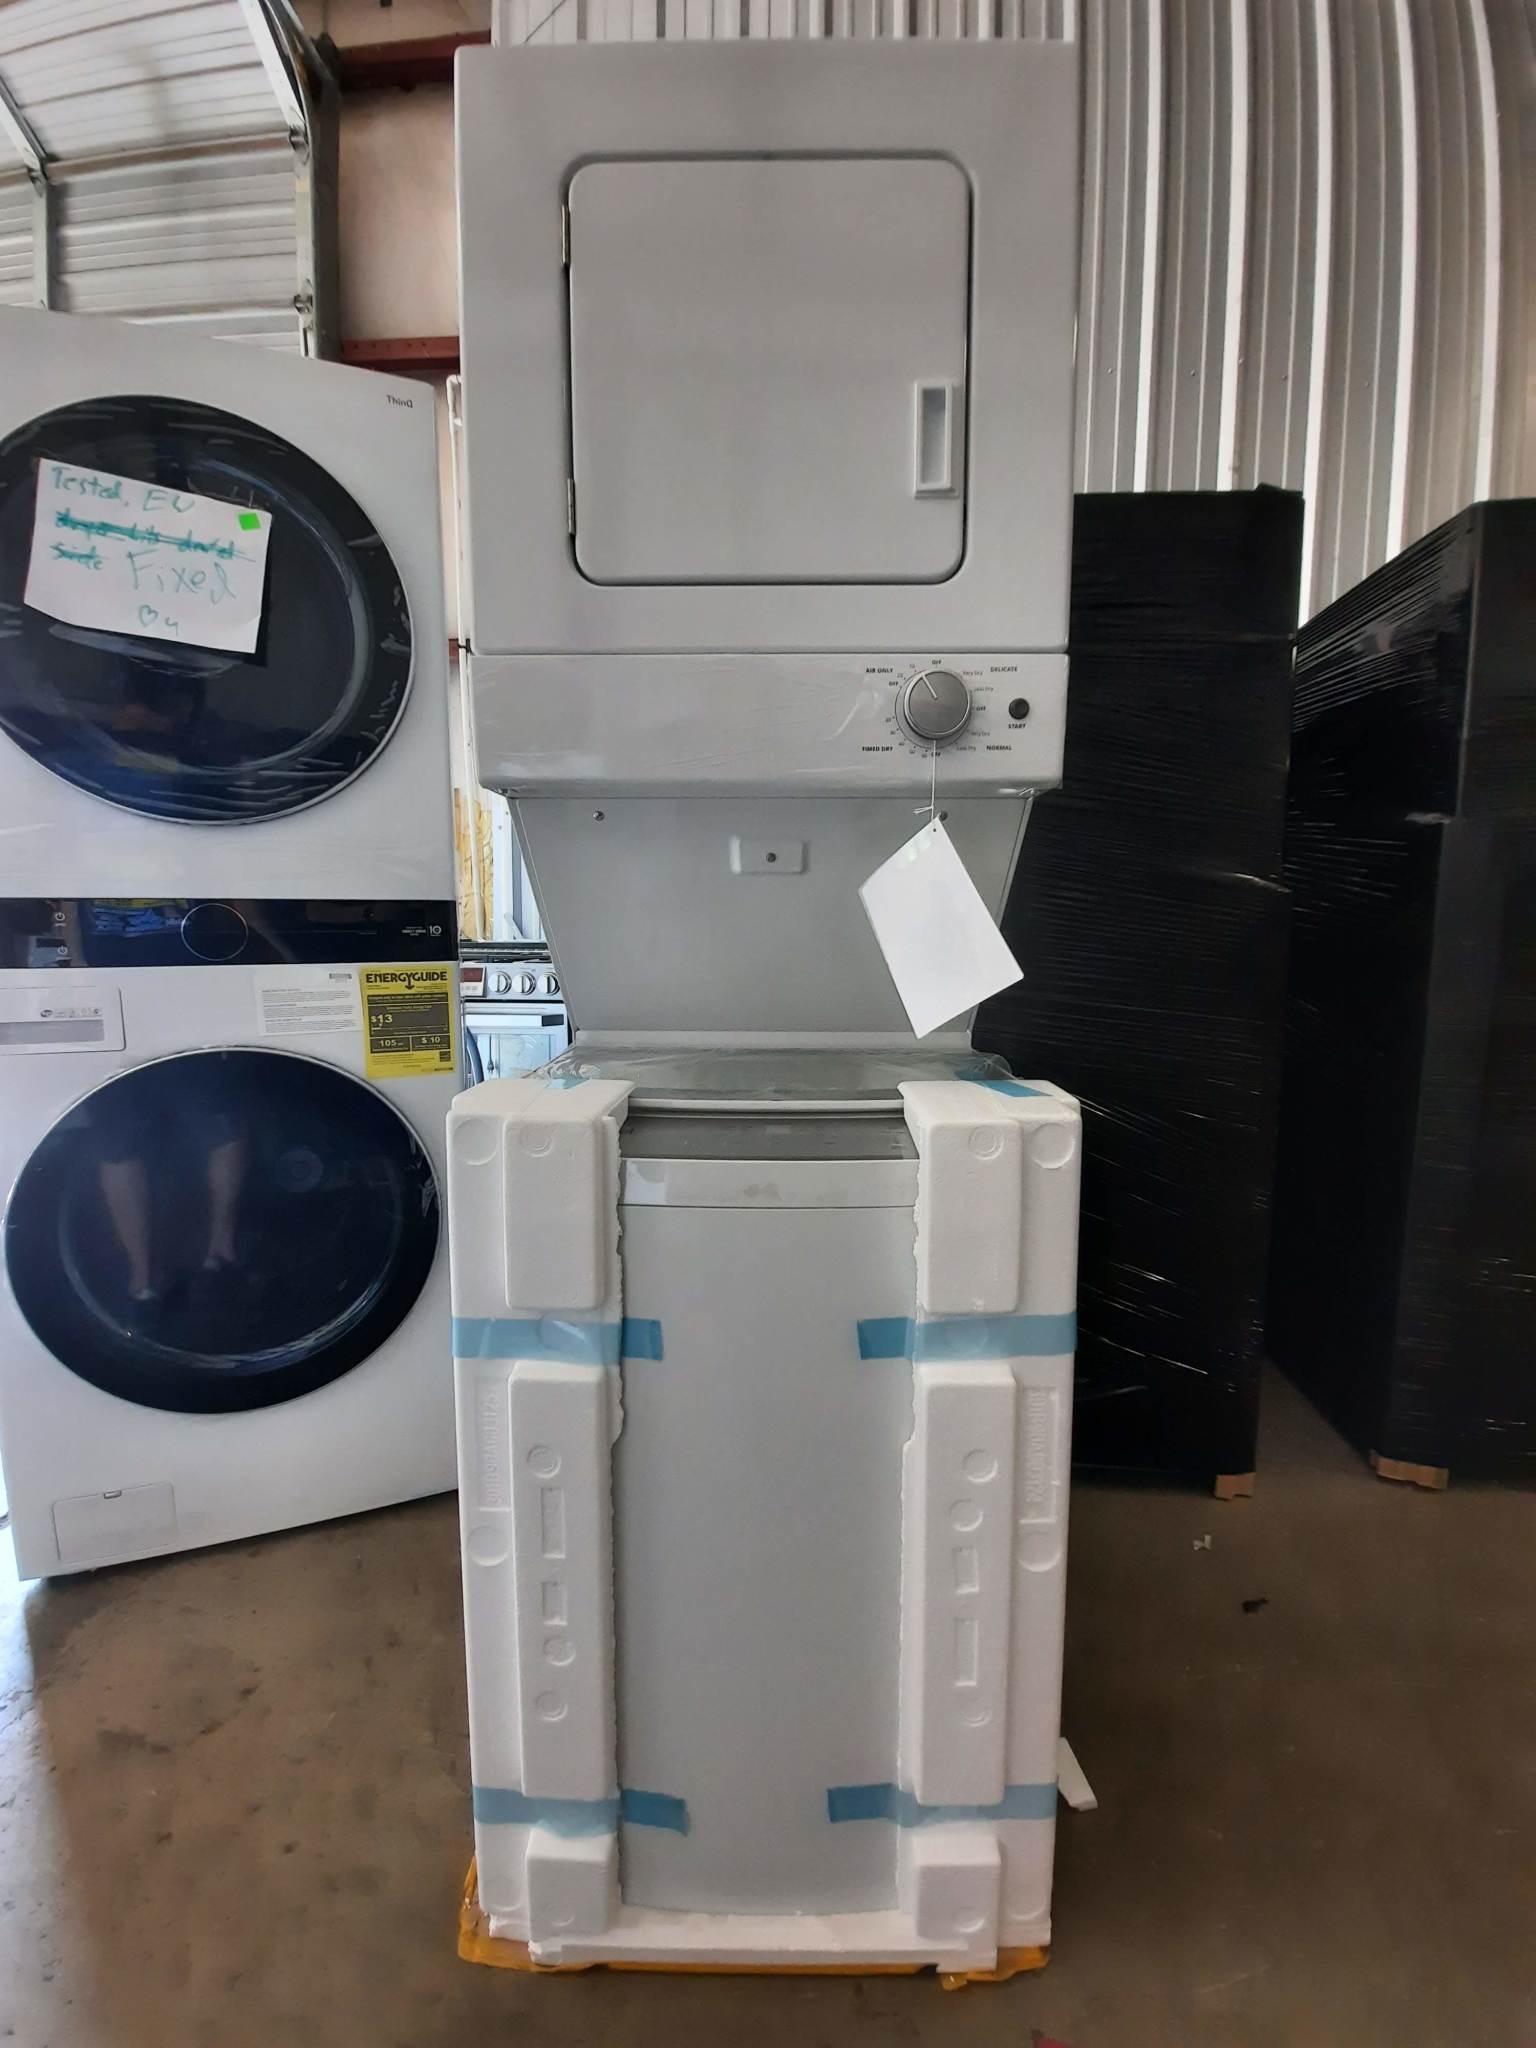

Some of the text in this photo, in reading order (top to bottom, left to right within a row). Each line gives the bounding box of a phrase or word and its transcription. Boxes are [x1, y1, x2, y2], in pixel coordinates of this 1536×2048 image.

[386, 394, 413, 409] ThinQ
[127, 549, 237, 605] Fixed
[366, 971, 448, 986] ENERGYGUIDE
[370, 1014, 393, 1023] $13
